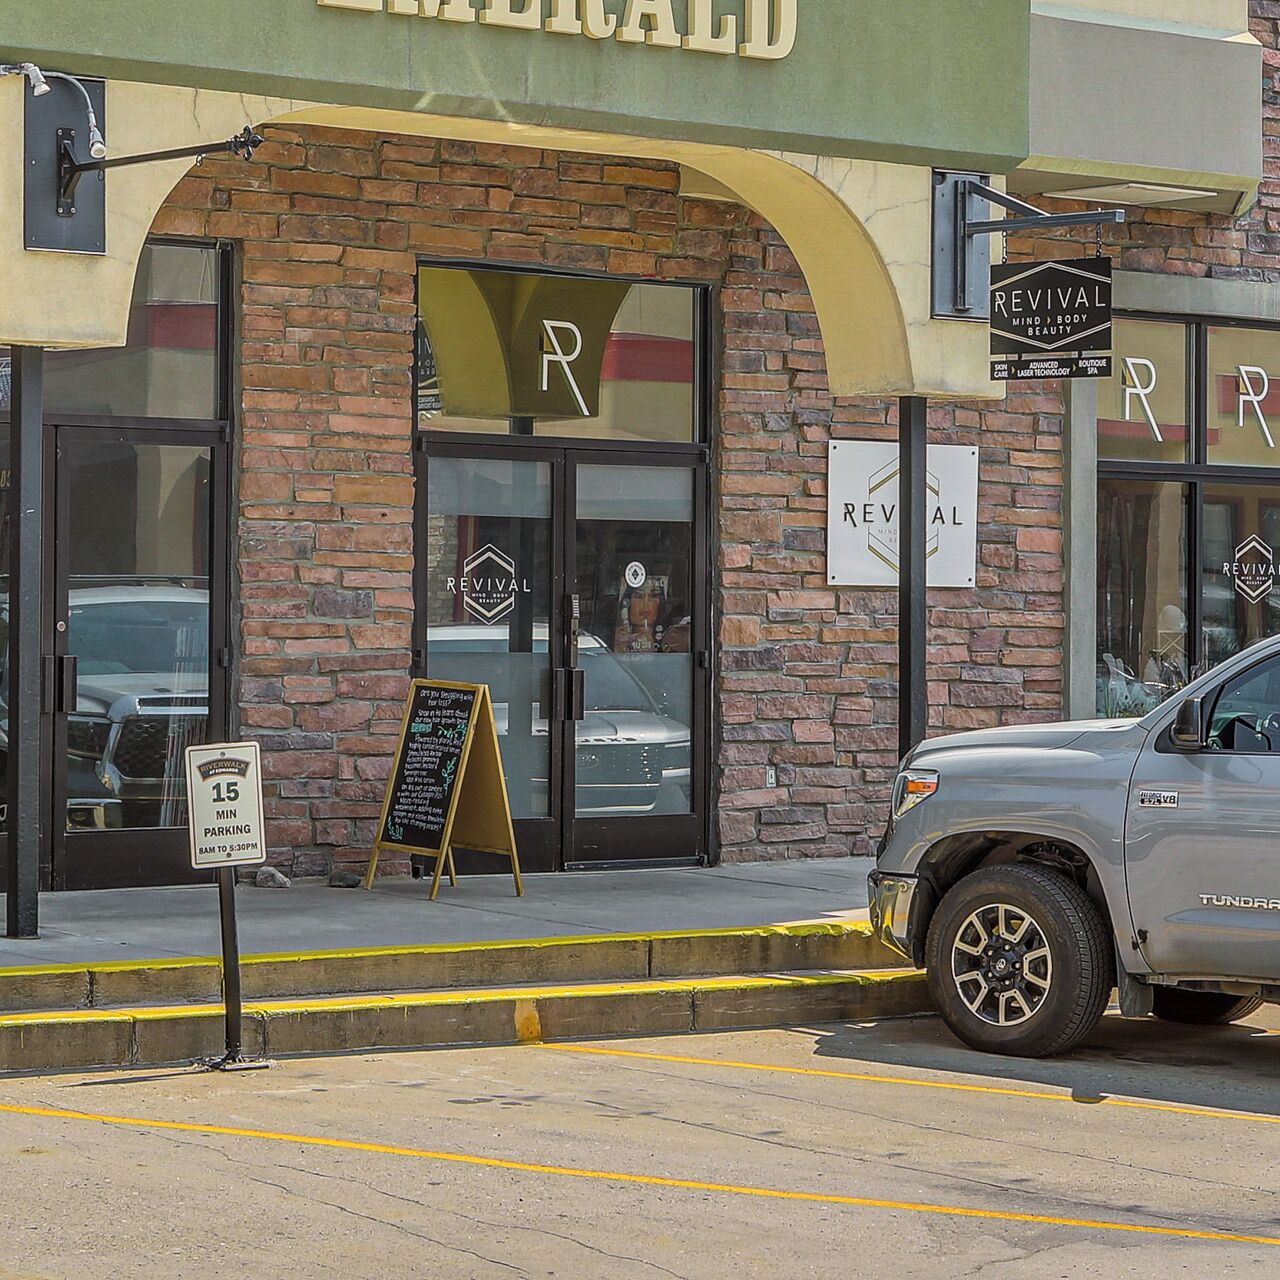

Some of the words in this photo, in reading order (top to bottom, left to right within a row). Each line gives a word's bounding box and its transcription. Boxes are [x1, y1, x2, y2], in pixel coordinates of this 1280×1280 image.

[995, 285, 1106, 318] REVIVAL
[1012, 316, 1041, 326] MIND
[1057, 314, 1087, 324] BODY
[1028, 326, 1071, 336] BEAUTY
[994, 363, 1008, 371] SKIN
[1029, 361, 1059, 369] ADVANCED
[1078, 359, 1107, 368] BOUTIQUE
[993, 370, 1008, 378] CARE
[1017, 369, 1034, 377] LASER
[1034, 367, 1070, 377] TECHNOLOGY
[1087, 367, 1098, 375] SPA
[843, 502, 963, 528] REVAL
[446, 577, 531, 594] REVIVAL
[200, 760, 247, 773] RIVERWALK
[211, 781, 240, 803] 15
[1162, 795, 1176, 804] V8
[215, 808, 237, 821] MIN
[203, 824, 251, 838] PARKING
[198, 846, 216, 855] 8AM
[217, 845, 228, 853] TO
[229, 842, 258, 852] 5:30PM
